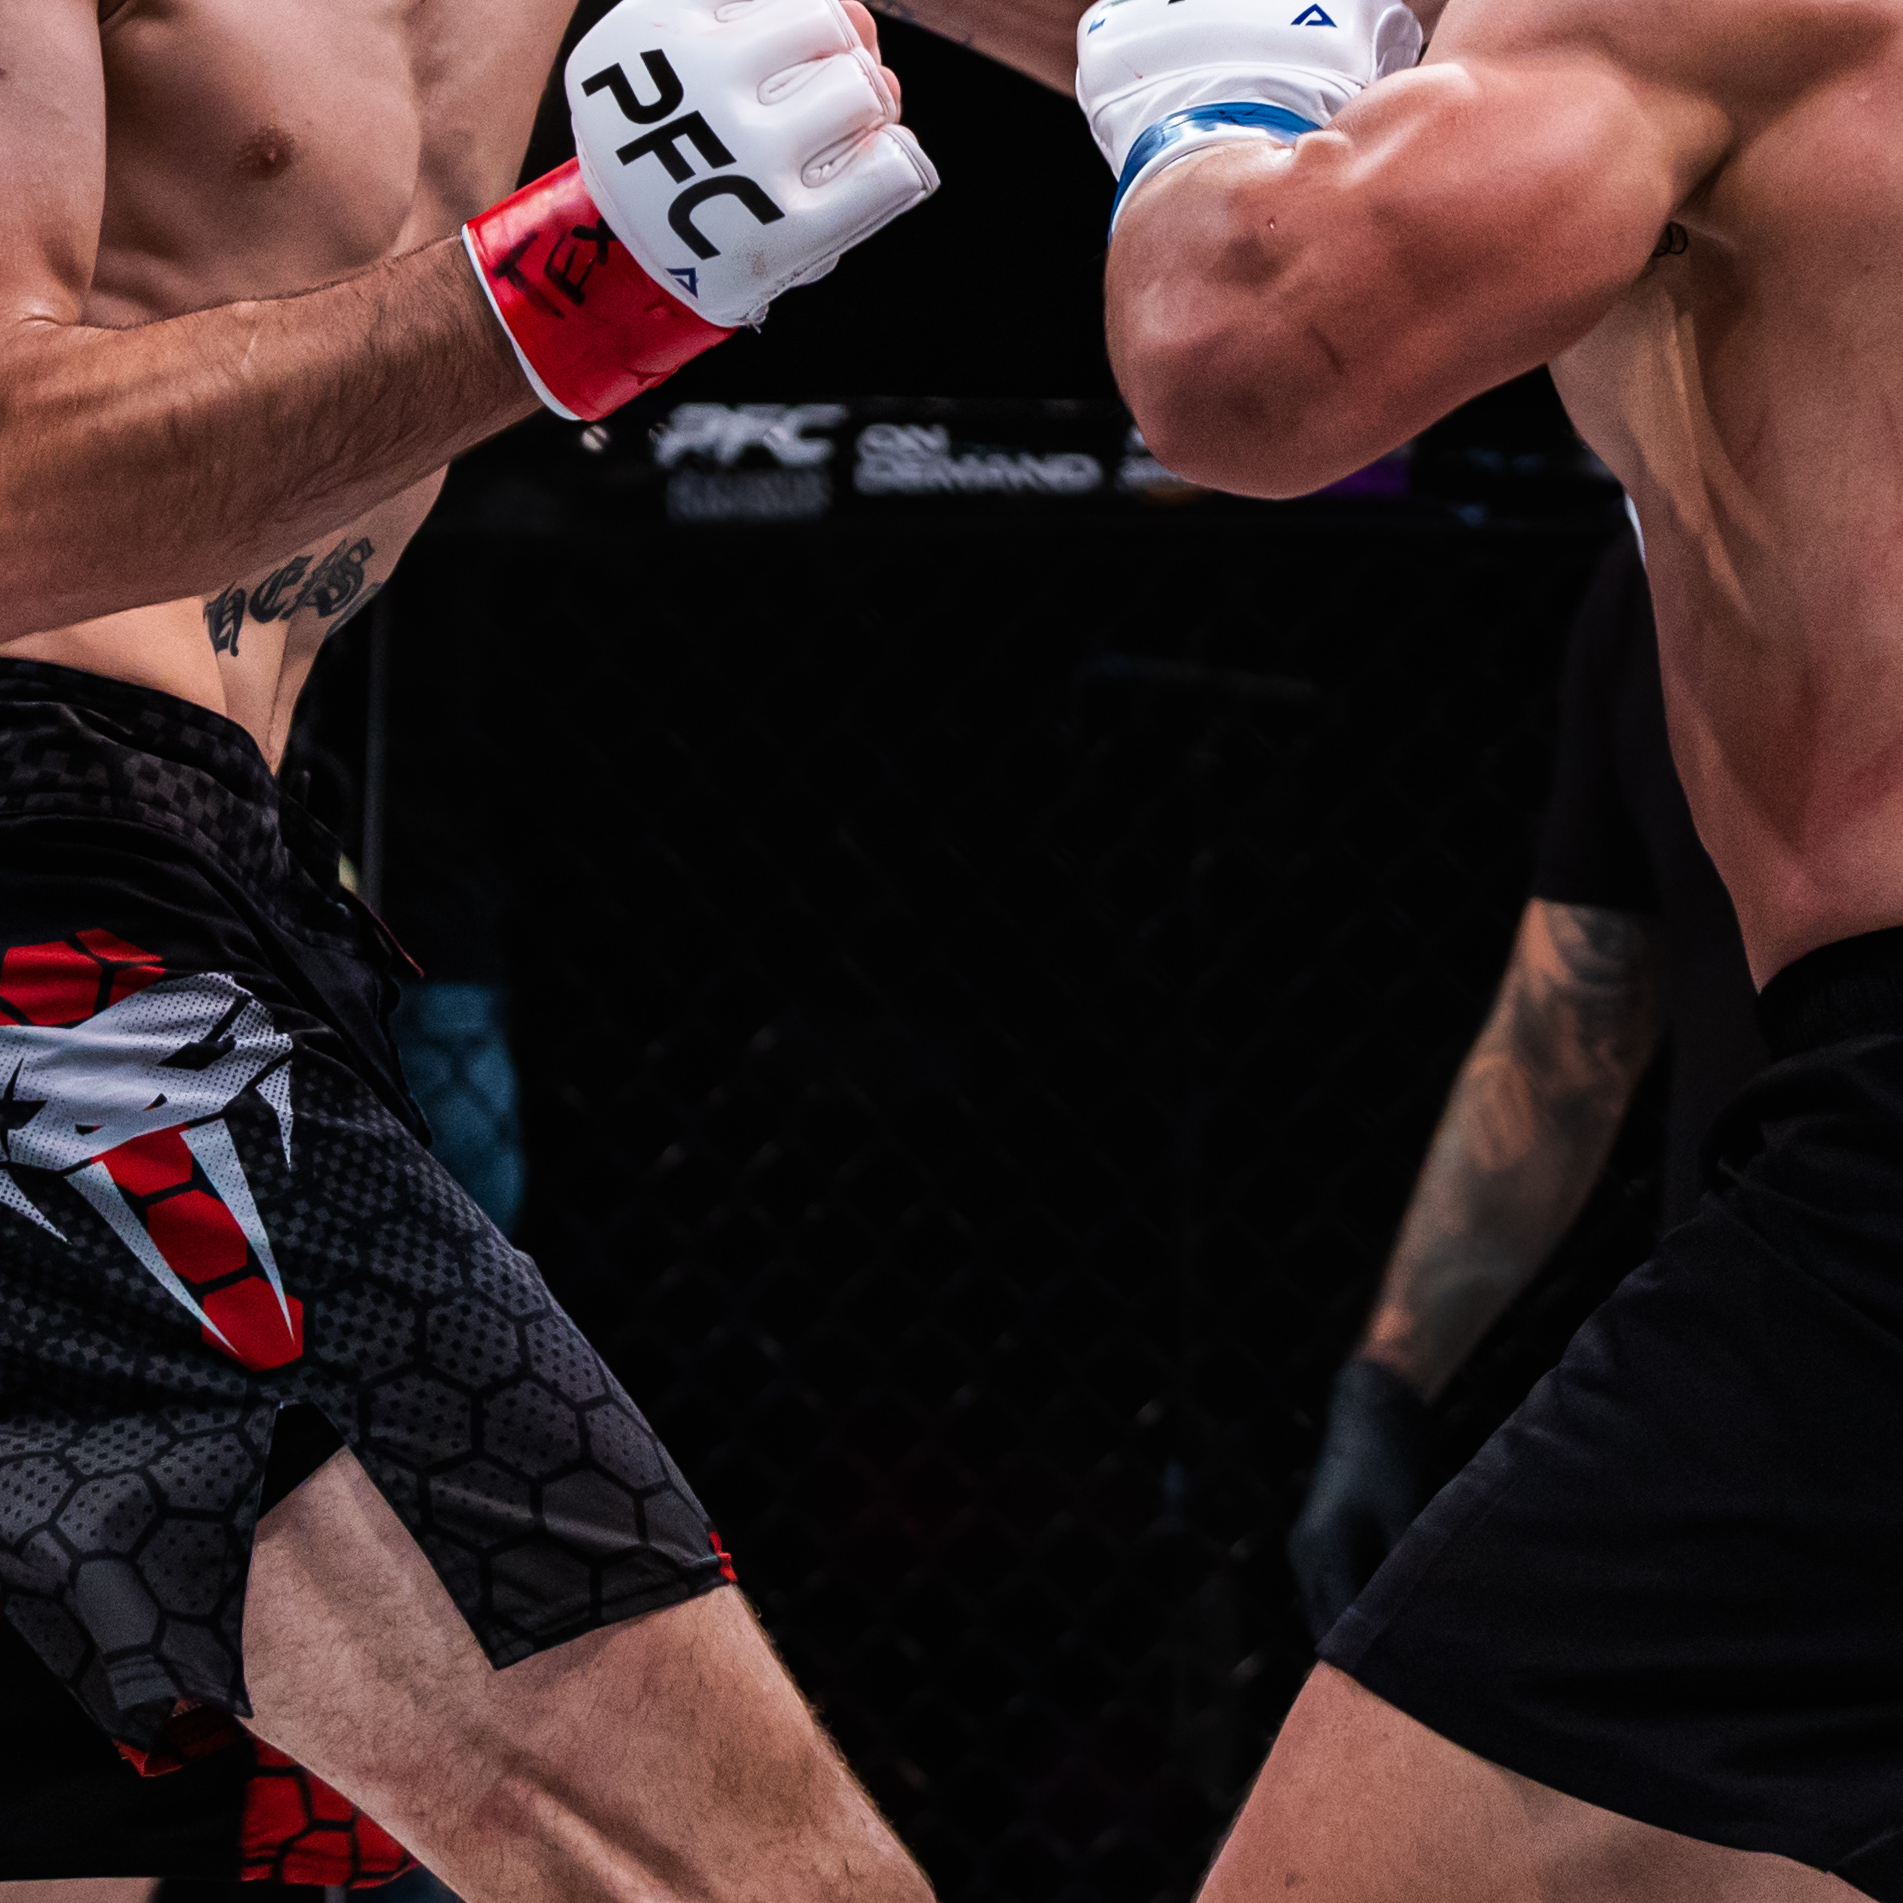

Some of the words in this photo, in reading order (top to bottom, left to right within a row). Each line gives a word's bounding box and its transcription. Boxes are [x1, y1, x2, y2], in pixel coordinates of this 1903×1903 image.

[581, 48, 786, 261] PFC
[654, 402, 849, 468] PFC
[855, 423, 950, 462] ON
[853, 453, 1103, 495] DEMAND
